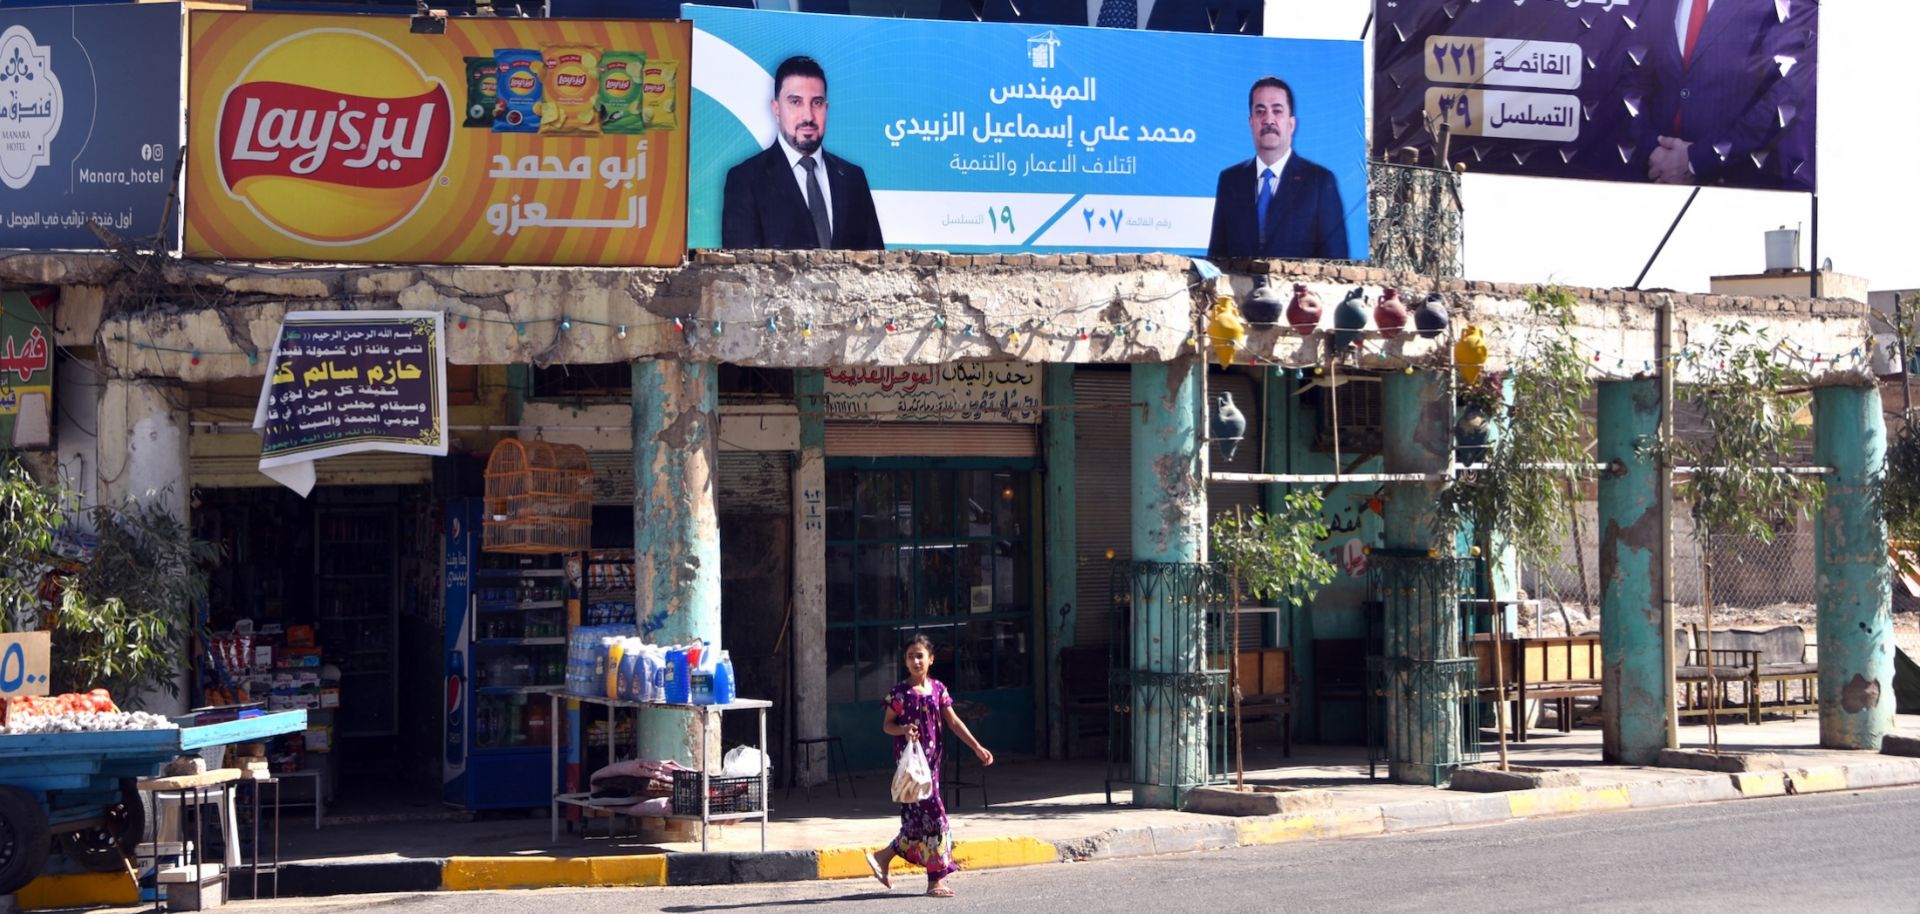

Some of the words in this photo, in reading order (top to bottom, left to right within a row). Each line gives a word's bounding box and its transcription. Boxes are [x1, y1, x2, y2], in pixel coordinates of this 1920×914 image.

[1432, 42, 1476, 76] ٢٢١
[1492, 51, 1571, 75] القائمة
[989, 77, 1097, 109] المهندس
[1438, 93, 1471, 129] ٣٩
[1490, 103, 1573, 129] التسلسل
[2, 130, 31, 139] MANARA
[231, 97, 367, 174] Lay's
[342, 102, 436, 171] ليز
[884, 111, 966, 148] الزبيدي
[971, 112, 1074, 148] إسماعيل
[1080, 116, 1130, 151] علي
[1136, 122, 1196, 143] محمد
[6, 143, 26, 151] HOTEL
[489, 154, 592, 180] محمد
[599, 140, 649, 189] أبو
[949, 152, 1017, 174] والتنمية
[1022, 153, 1077, 176] الاعمار
[1081, 155, 1136, 175] ائتلاف
[79, 168, 164, 185] Manara_hotel
[6, 211, 40, 229] الموصل
[41, 213, 58, 229] في
[61, 209, 85, 228] تراثي
[115, 207, 132, 229] أول
[942, 214, 984, 226] التسلسل
[988, 205, 1015, 234] ١٩
[1083, 207, 1124, 233] ٢٠٧
[1126, 216, 1154, 227] القائمة
[1155, 219, 1172, 229] رقم
[312, 330, 342, 341] الرحيم
[343, 329, 376, 341] الرحمن
[377, 329, 392, 338] الله
[393, 331, 412, 339] بسم
[303, 361, 359, 388] سالم
[366, 359, 423, 384] حازم
[995, 362, 1034, 385] تحف
[307, 386, 328, 399] من
[334, 385, 354, 397] كل
[358, 384, 399, 396] شقيقة
[282, 406, 292, 421] في
[297, 401, 332, 417] العزاء
[337, 399, 375, 413] مجلس
[380, 401, 427, 413] وسيقام
[299, 416, 341, 430] والسبت
[344, 413, 381, 425] الجمعة
[383, 414, 419, 427] ليومي
